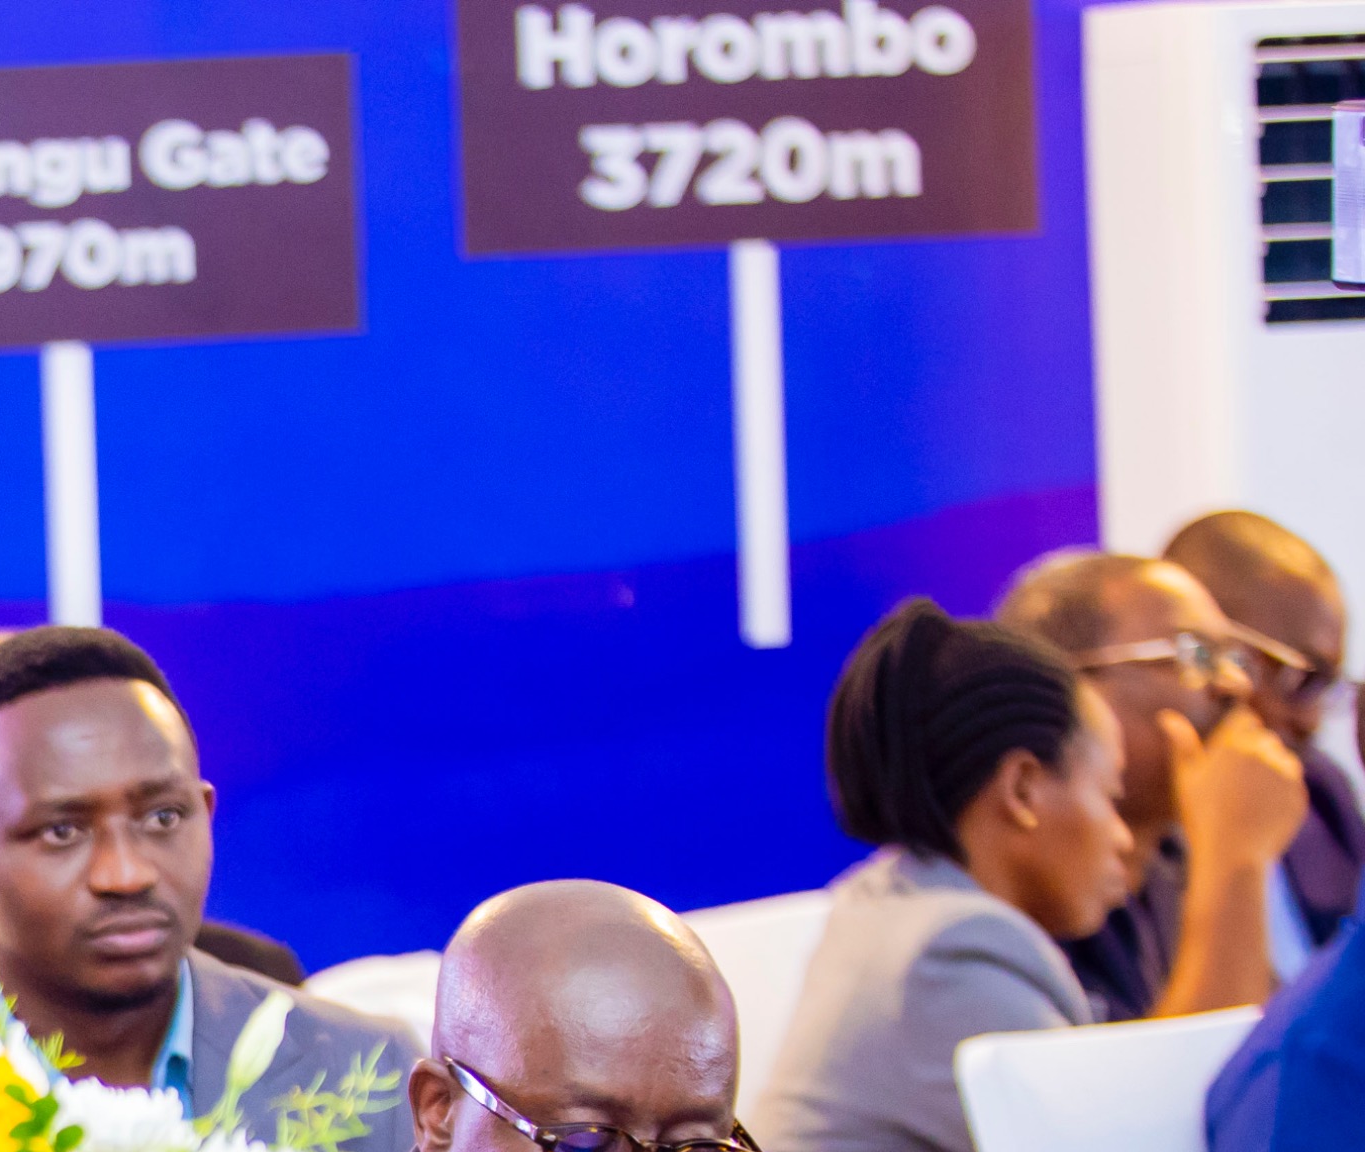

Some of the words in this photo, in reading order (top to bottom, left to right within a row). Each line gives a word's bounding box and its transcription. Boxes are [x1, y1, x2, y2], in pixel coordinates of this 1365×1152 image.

[514, 0, 978, 90] Horombo
[138, 116, 330, 191] Gate
[577, 115, 923, 212] 3720m
